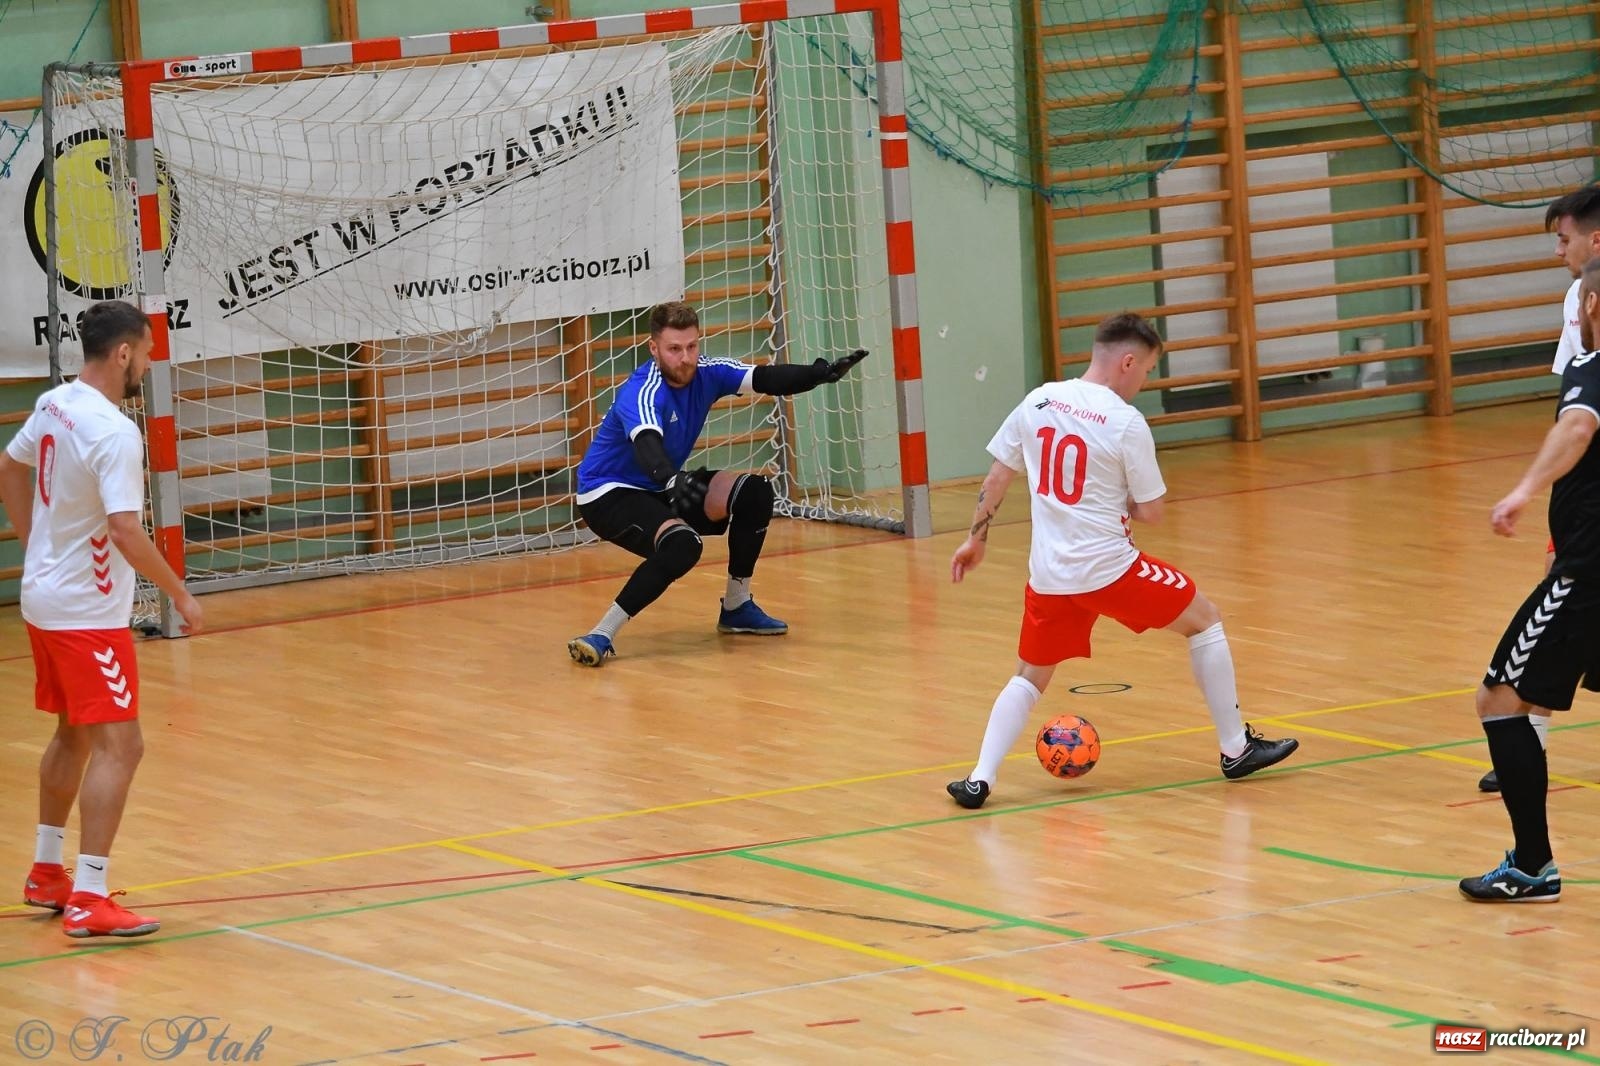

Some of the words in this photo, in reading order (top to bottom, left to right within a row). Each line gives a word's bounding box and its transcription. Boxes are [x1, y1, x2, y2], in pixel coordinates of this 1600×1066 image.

[205, 59, 236, 72] sport
[218, 229, 321, 310] JEST
[331, 208, 377, 254] W
[394, 247, 651, 301] www.osir-raciborz.pl
[1049, 400, 1072, 414] PRD
[1073, 408, 1107, 425] KÜHN
[1037, 427, 1088, 506] 10
